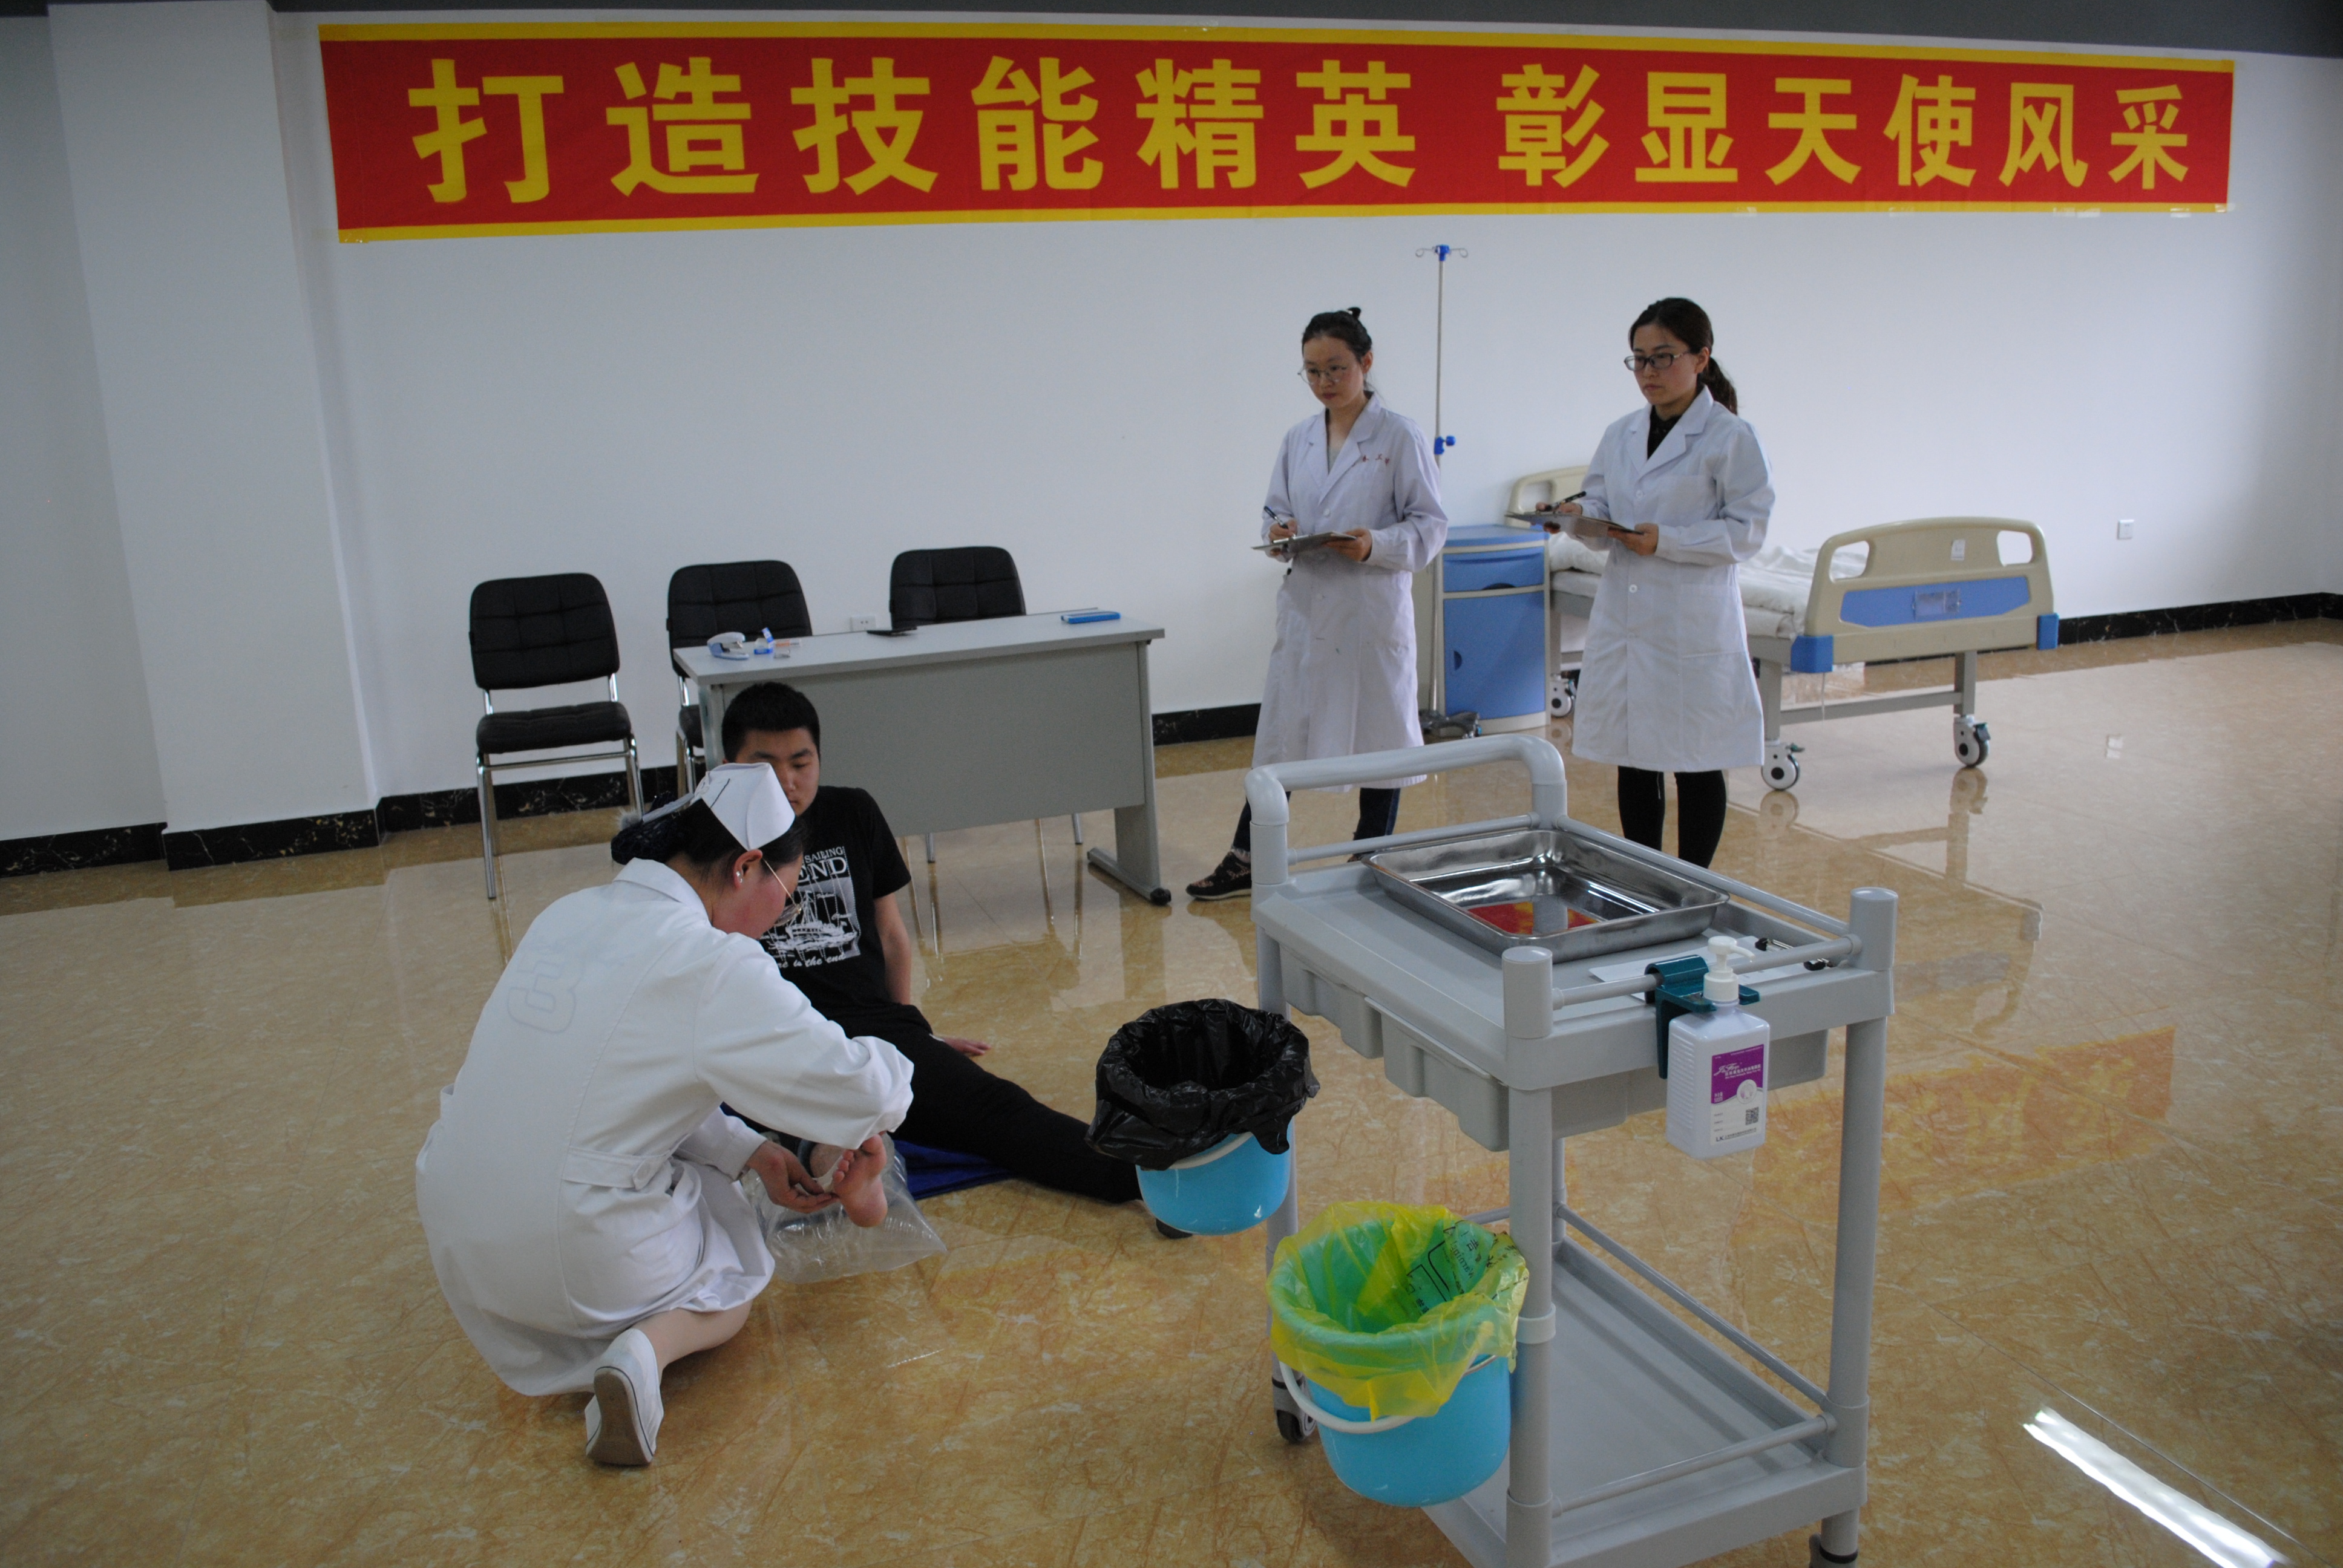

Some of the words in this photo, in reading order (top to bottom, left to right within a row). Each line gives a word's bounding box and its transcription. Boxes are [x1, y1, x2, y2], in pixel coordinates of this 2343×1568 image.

[407, 55, 1416, 204] 打造技能精英
[1495, 64, 2189, 190] 彰显天使风采
[804, 846, 843, 864] SAILING
[805, 956, 823, 967] the
[826, 952, 846, 964] end
